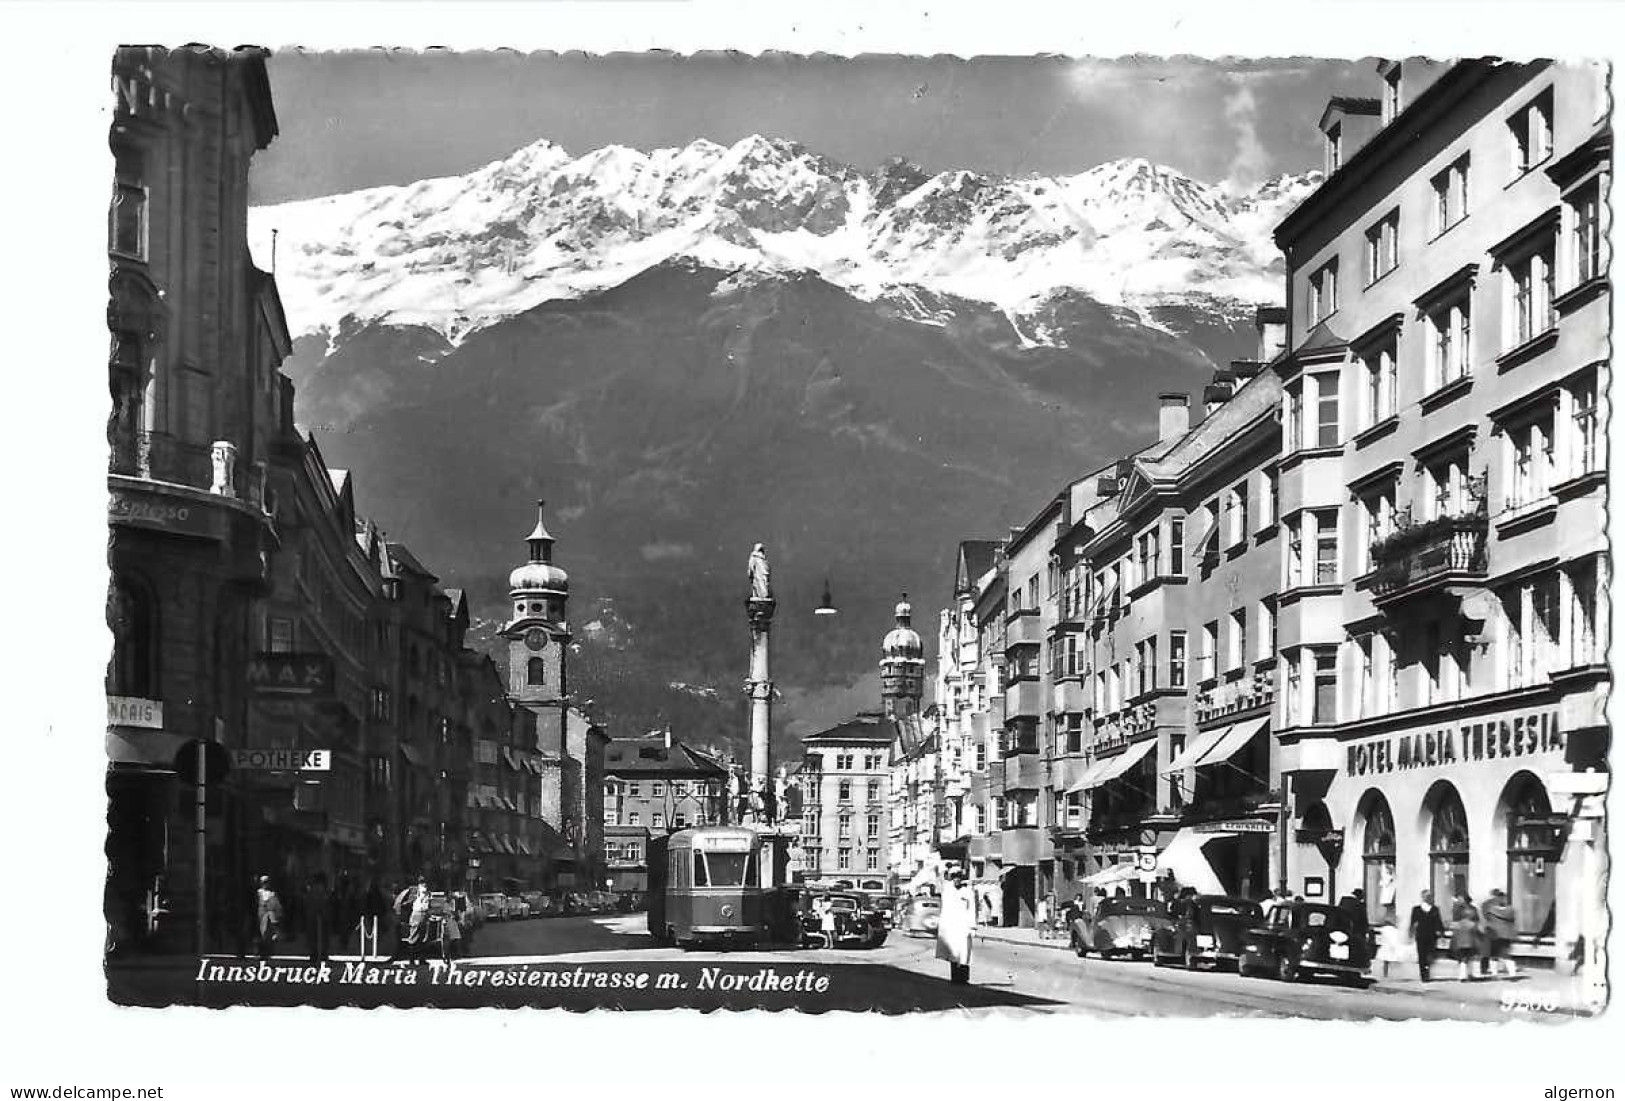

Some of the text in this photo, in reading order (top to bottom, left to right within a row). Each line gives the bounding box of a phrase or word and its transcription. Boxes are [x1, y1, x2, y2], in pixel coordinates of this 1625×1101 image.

[246, 661, 323, 685] MAX
[1347, 711, 1564, 777] HOTEL MARIA THERESIA
[230, 751, 322, 767] POTHEKE
